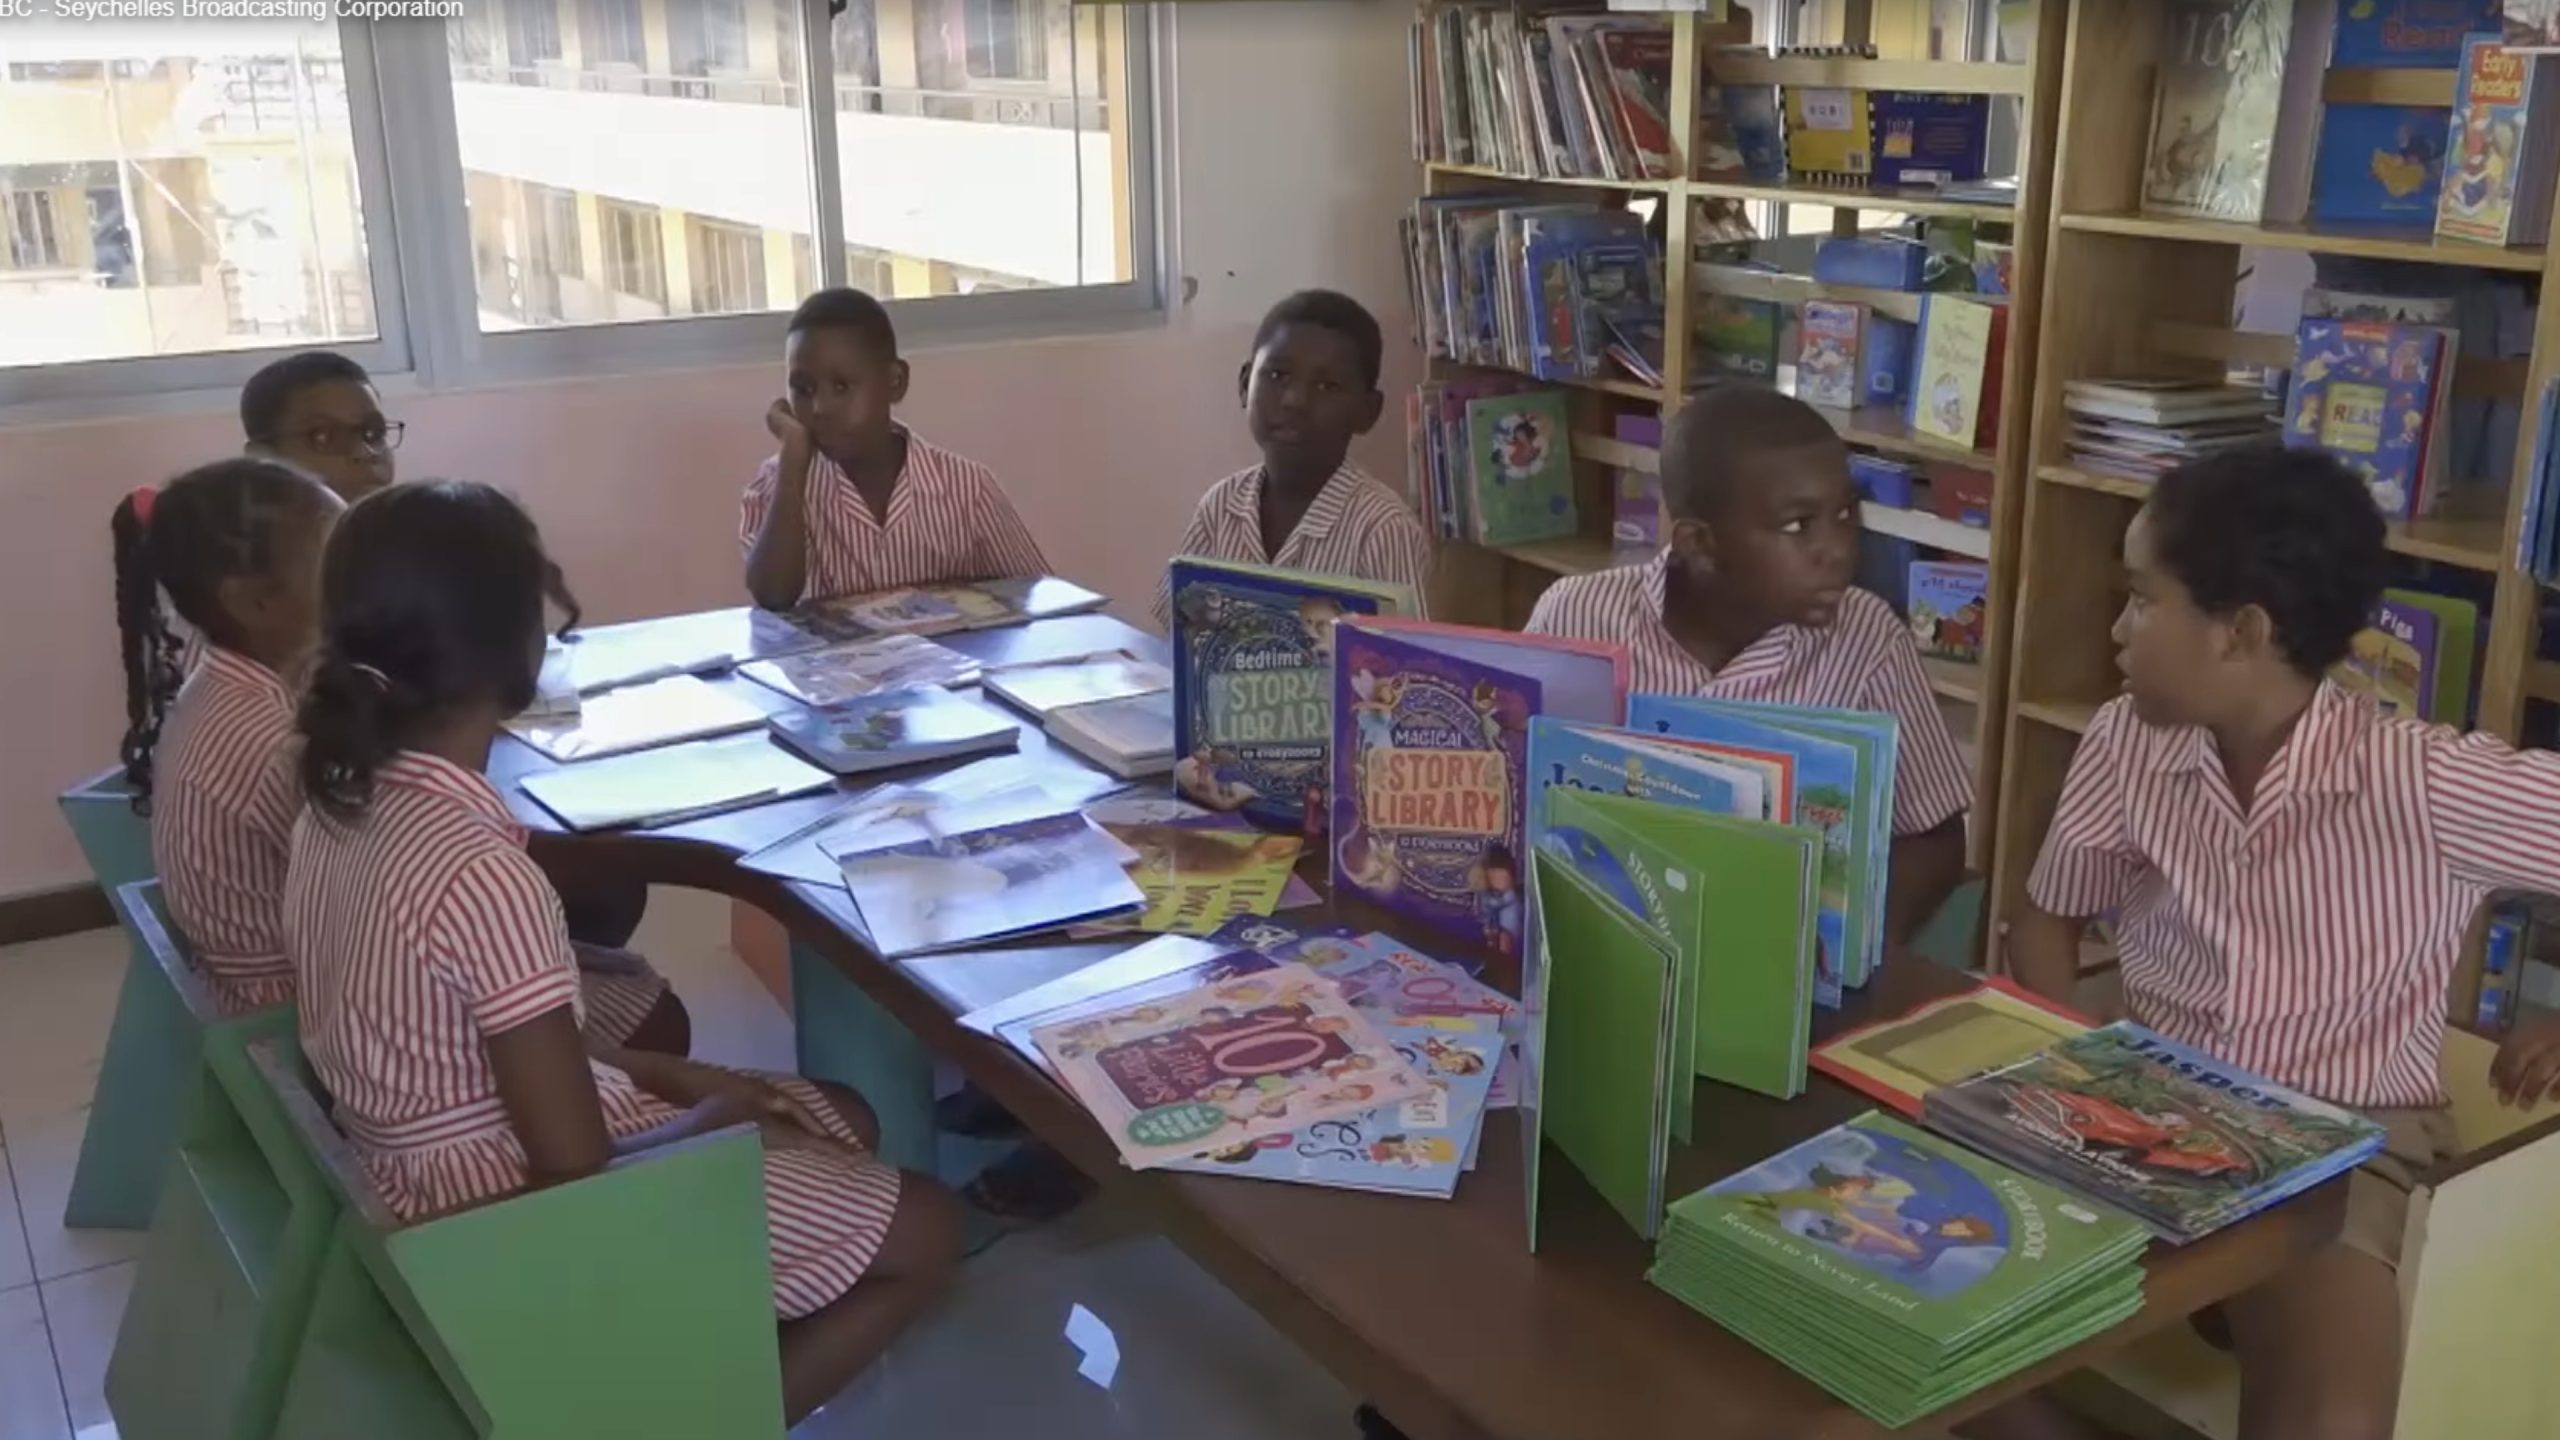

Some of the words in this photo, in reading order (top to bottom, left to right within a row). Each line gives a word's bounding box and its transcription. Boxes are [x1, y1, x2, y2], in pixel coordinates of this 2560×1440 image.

[1234, 647, 1302, 671] Bedtime
[1230, 671, 1319, 712] STORY
[1388, 752, 1487, 792] STORY
[1372, 790, 1501, 832] LIBRARY
[1192, 1014, 1327, 1075] 10
[2115, 1036, 2290, 1110] Jasper
[1720, 1211, 1779, 1248] Return
[1781, 1239, 1801, 1258] to
[1804, 1250, 1863, 1287] Never
[1864, 1279, 1921, 1312] Land
